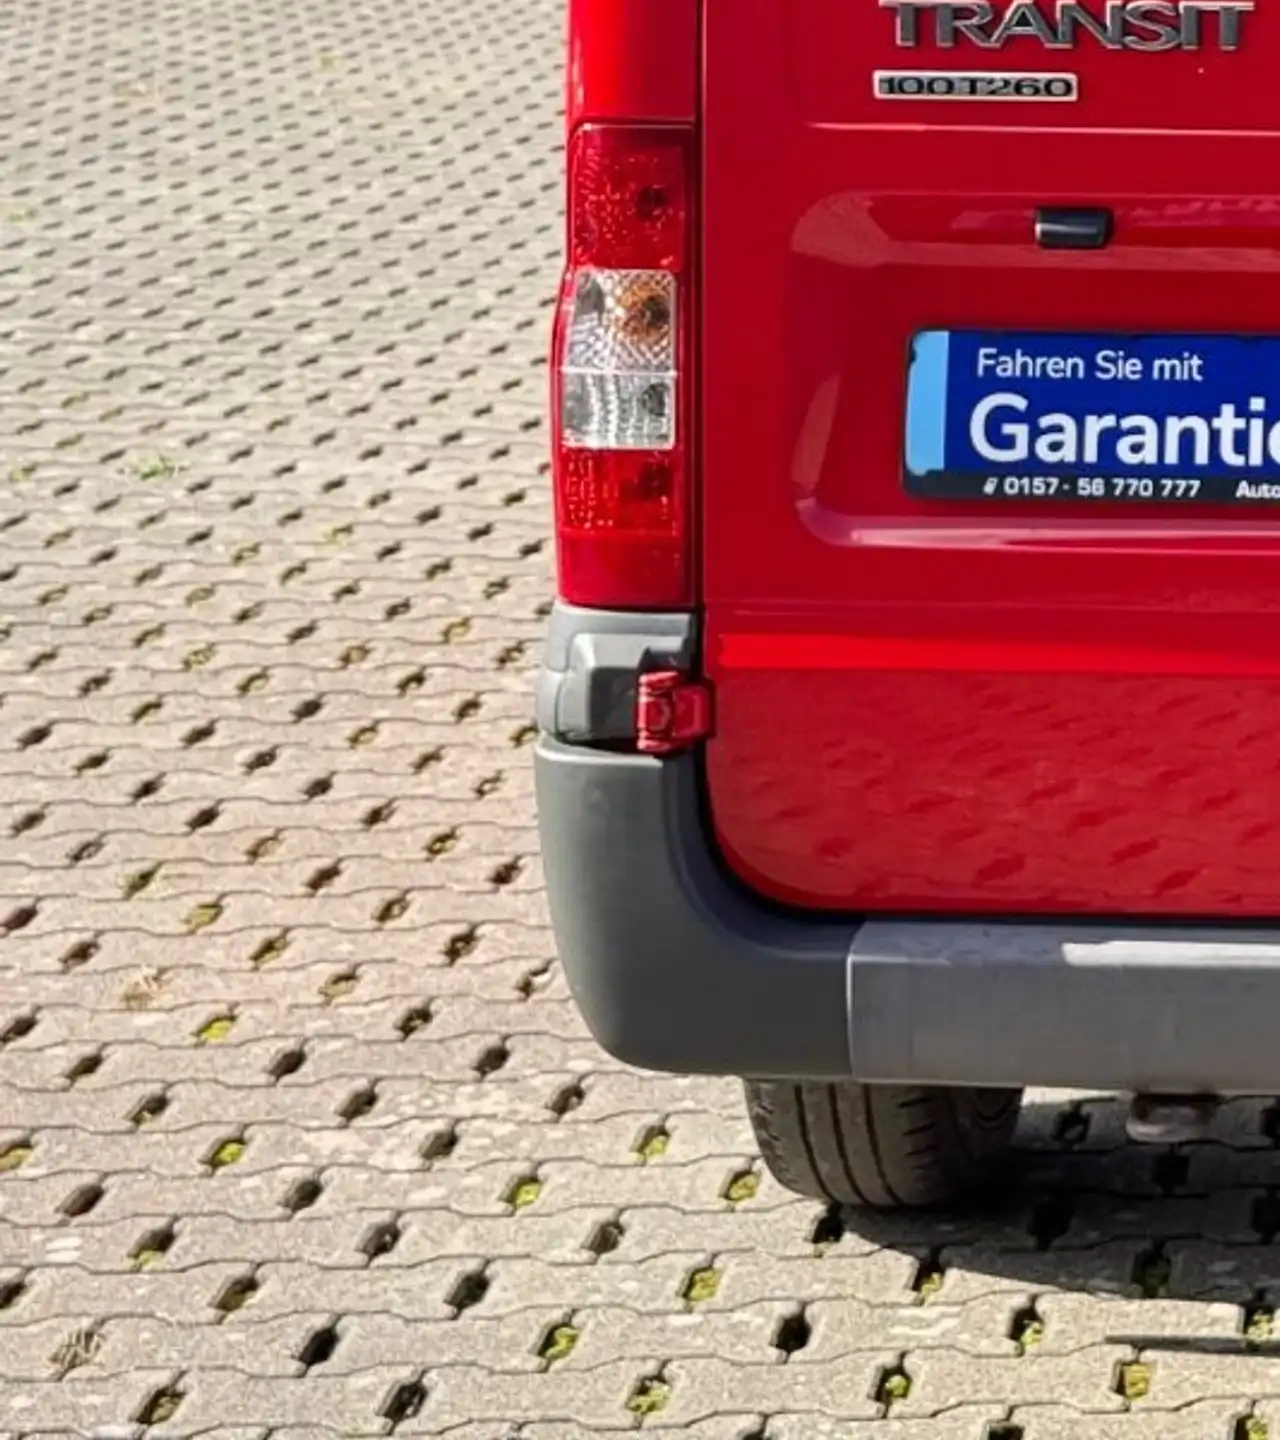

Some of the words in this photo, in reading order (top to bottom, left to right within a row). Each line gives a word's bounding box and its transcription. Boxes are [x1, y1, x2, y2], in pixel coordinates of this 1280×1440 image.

[879, 75, 1074, 98] 100T260
[976, 347, 1085, 378] Fahren
[1094, 350, 1143, 380] Sie
[1152, 352, 1204, 381] mit
[1112, 479, 1153, 497] 770
[1160, 479, 1201, 498] 777
